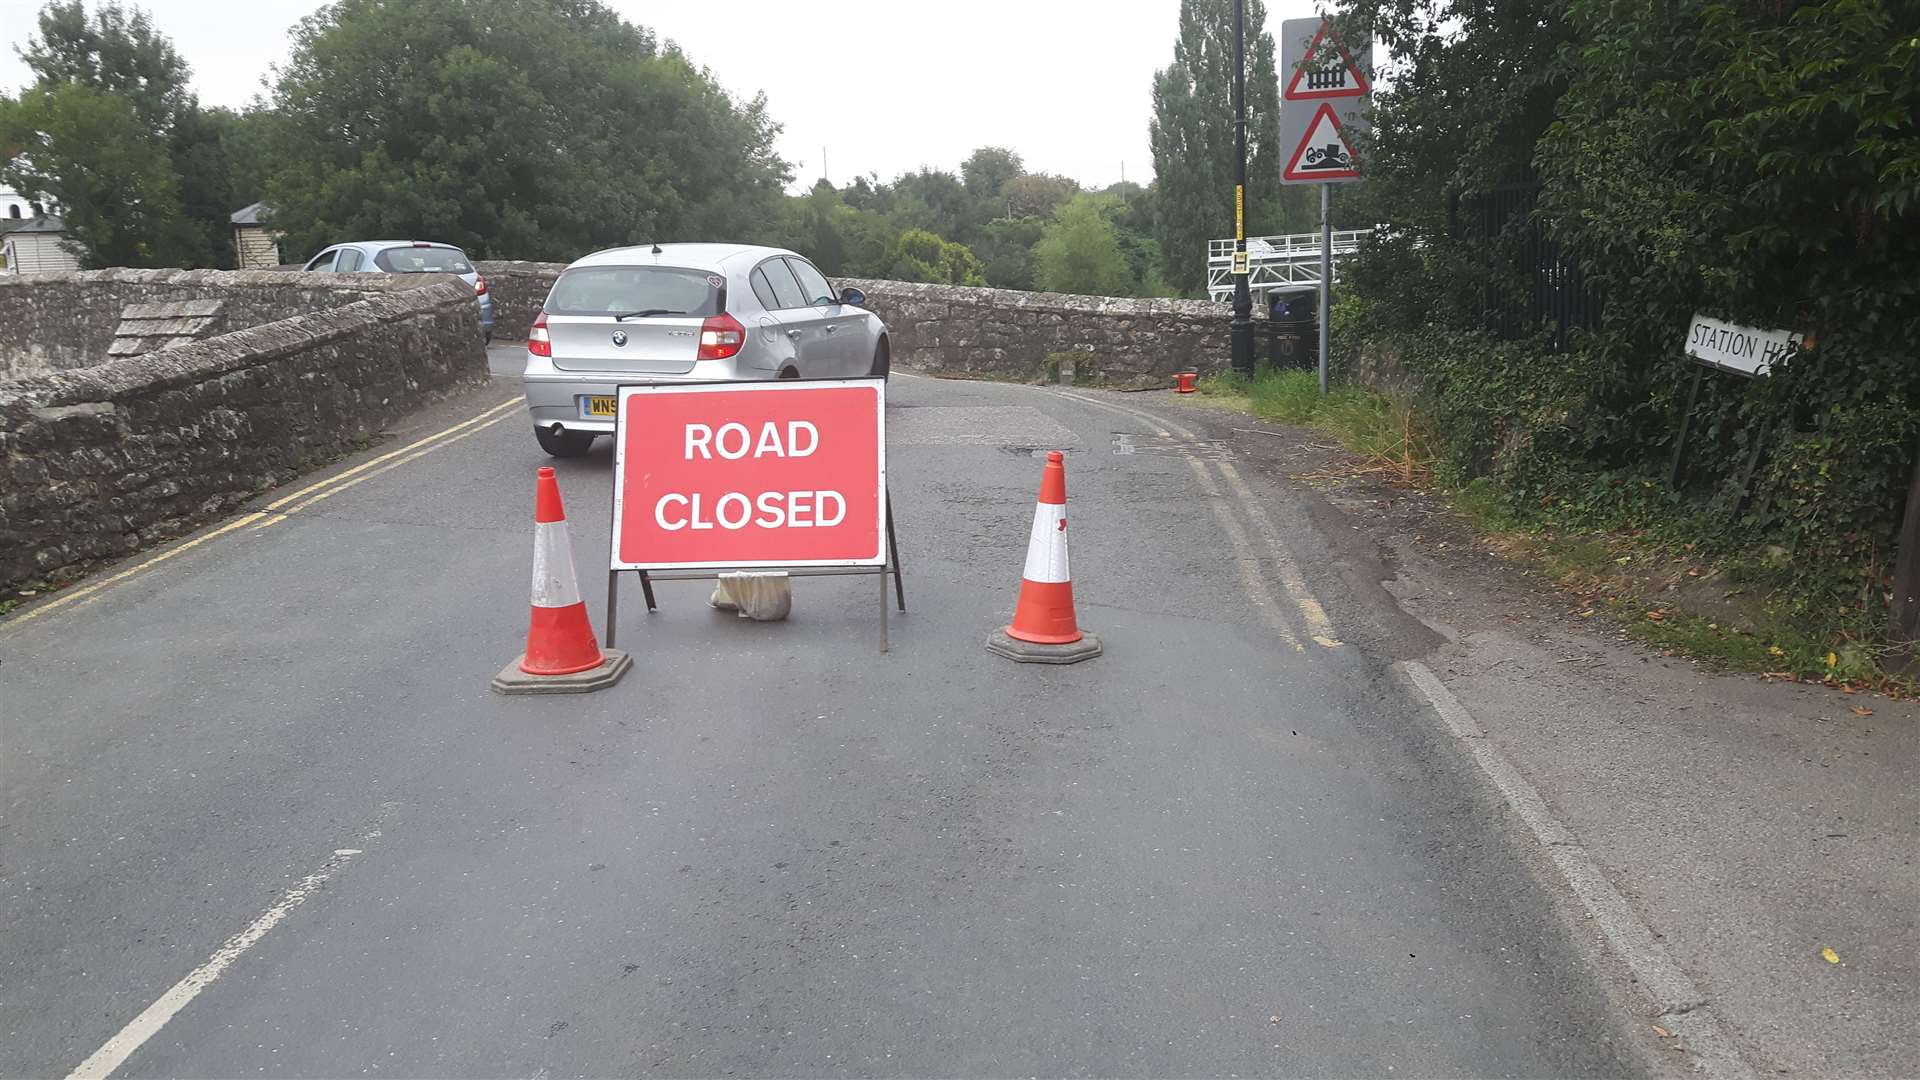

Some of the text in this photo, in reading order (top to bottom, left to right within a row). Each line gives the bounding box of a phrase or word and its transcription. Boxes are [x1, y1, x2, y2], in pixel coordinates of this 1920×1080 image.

[1692, 323, 1758, 358] STATION
[685, 421, 819, 460] ROAD
[655, 491, 847, 531] CLOSED
